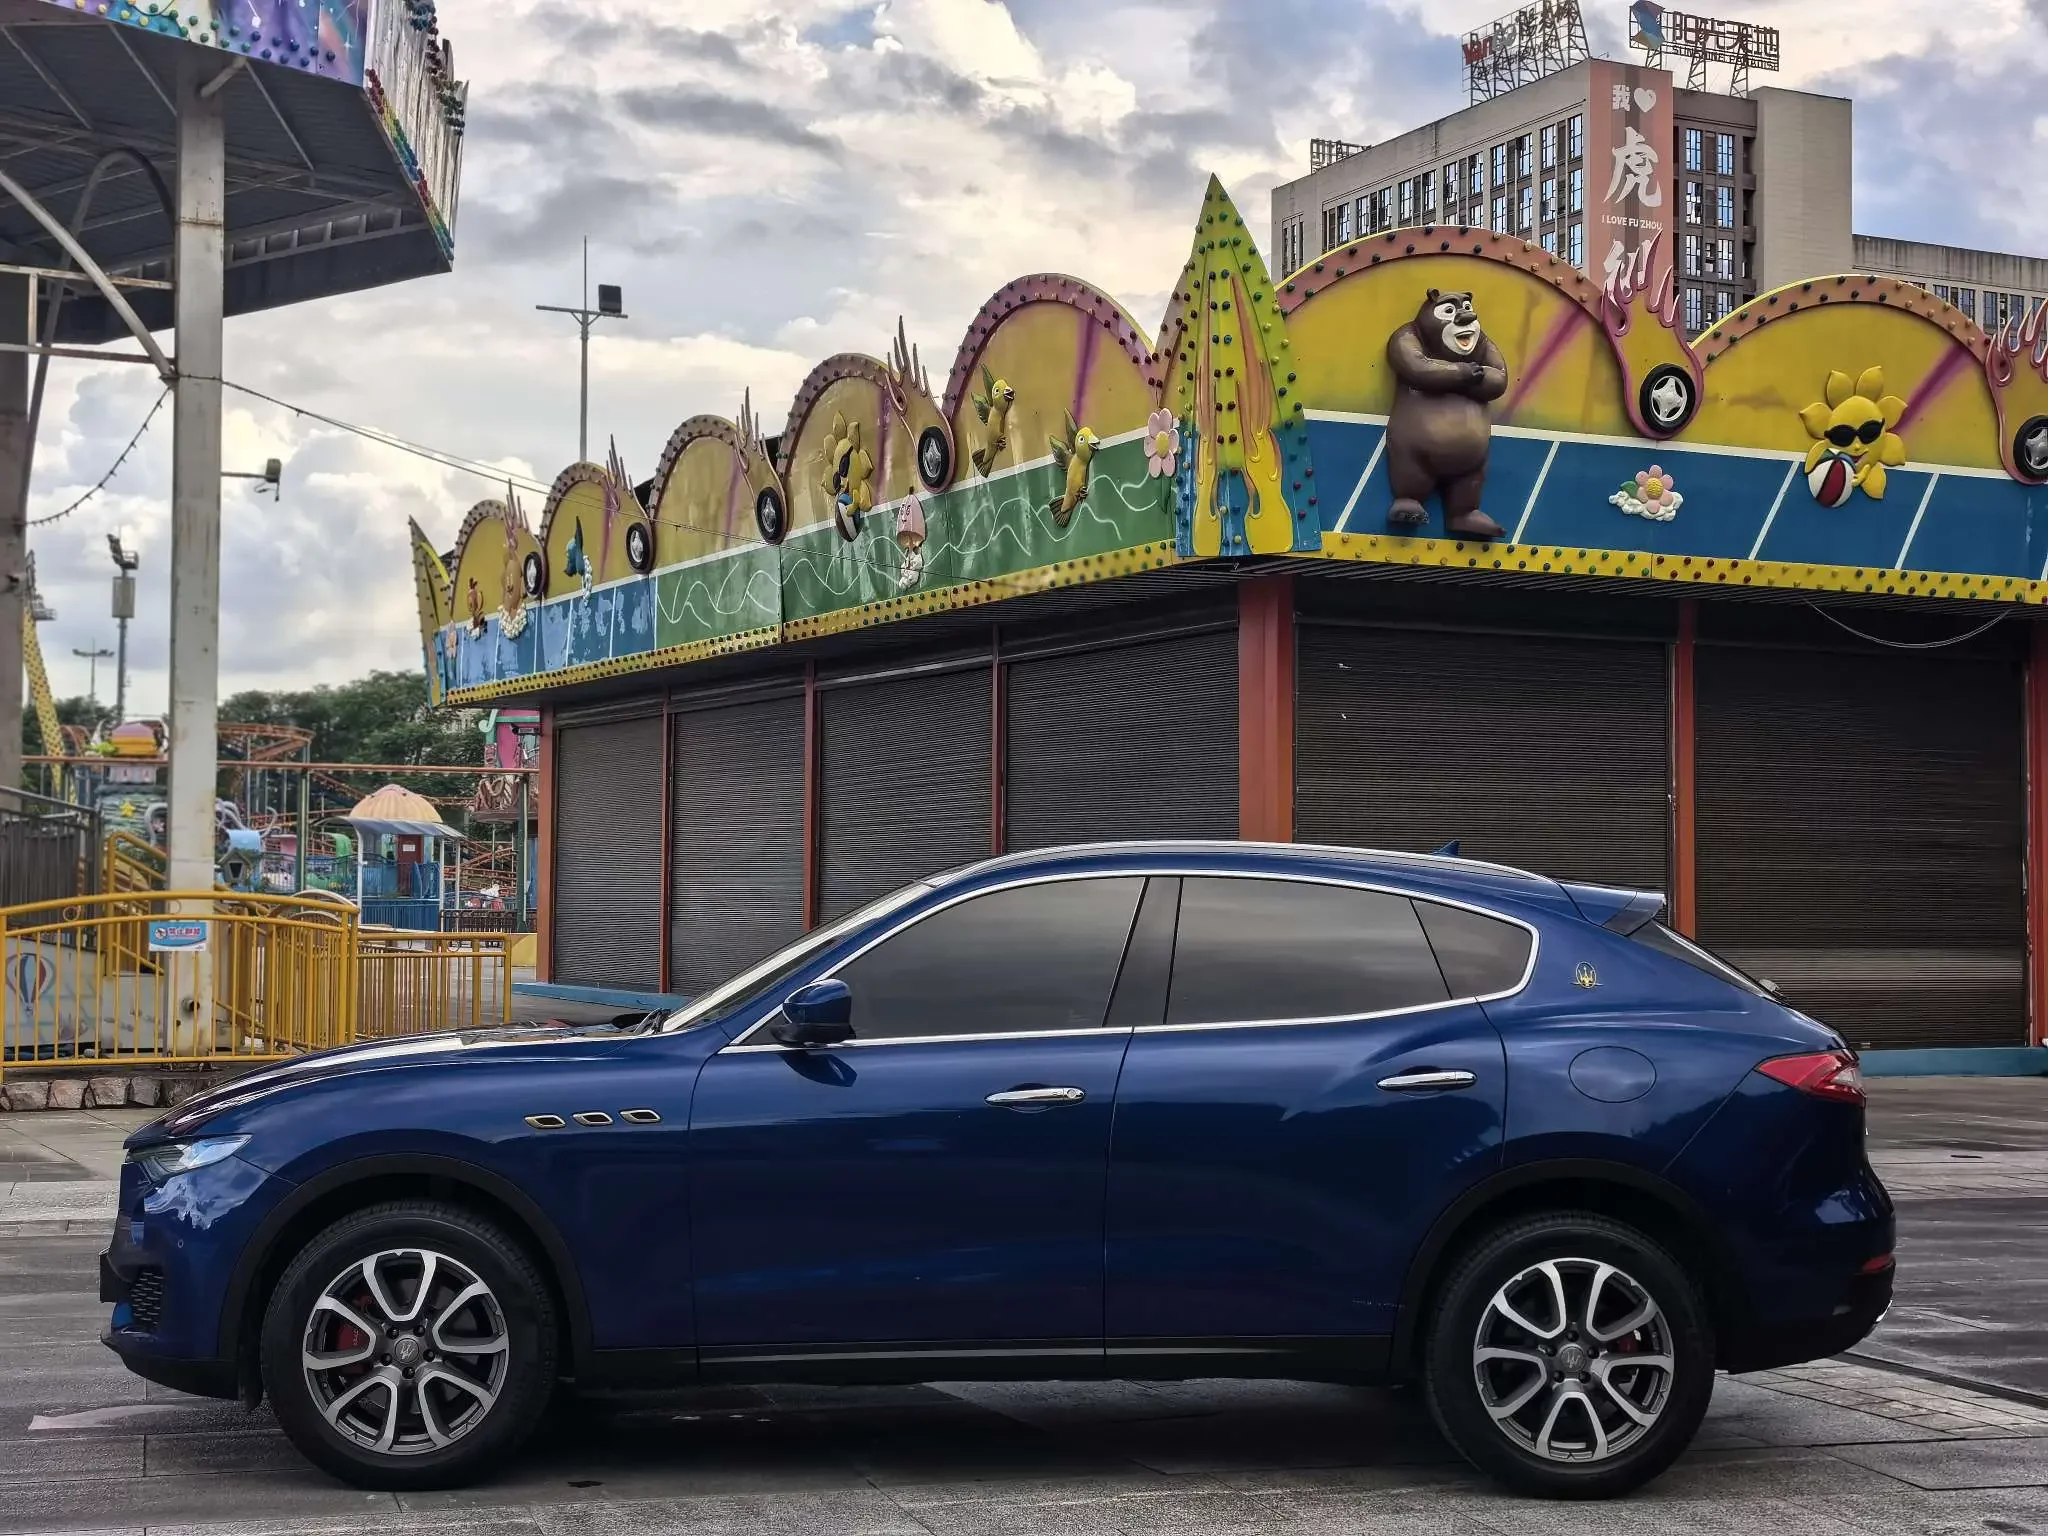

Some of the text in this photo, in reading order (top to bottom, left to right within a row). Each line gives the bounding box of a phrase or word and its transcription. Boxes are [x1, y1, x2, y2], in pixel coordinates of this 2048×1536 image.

[1612, 84, 1631, 112] 我
[1603, 126, 1662, 208] 虎
[1606, 214, 1628, 226] LOVE
[1628, 218, 1639, 227] FU
[1640, 219, 1663, 230] ZHOU
